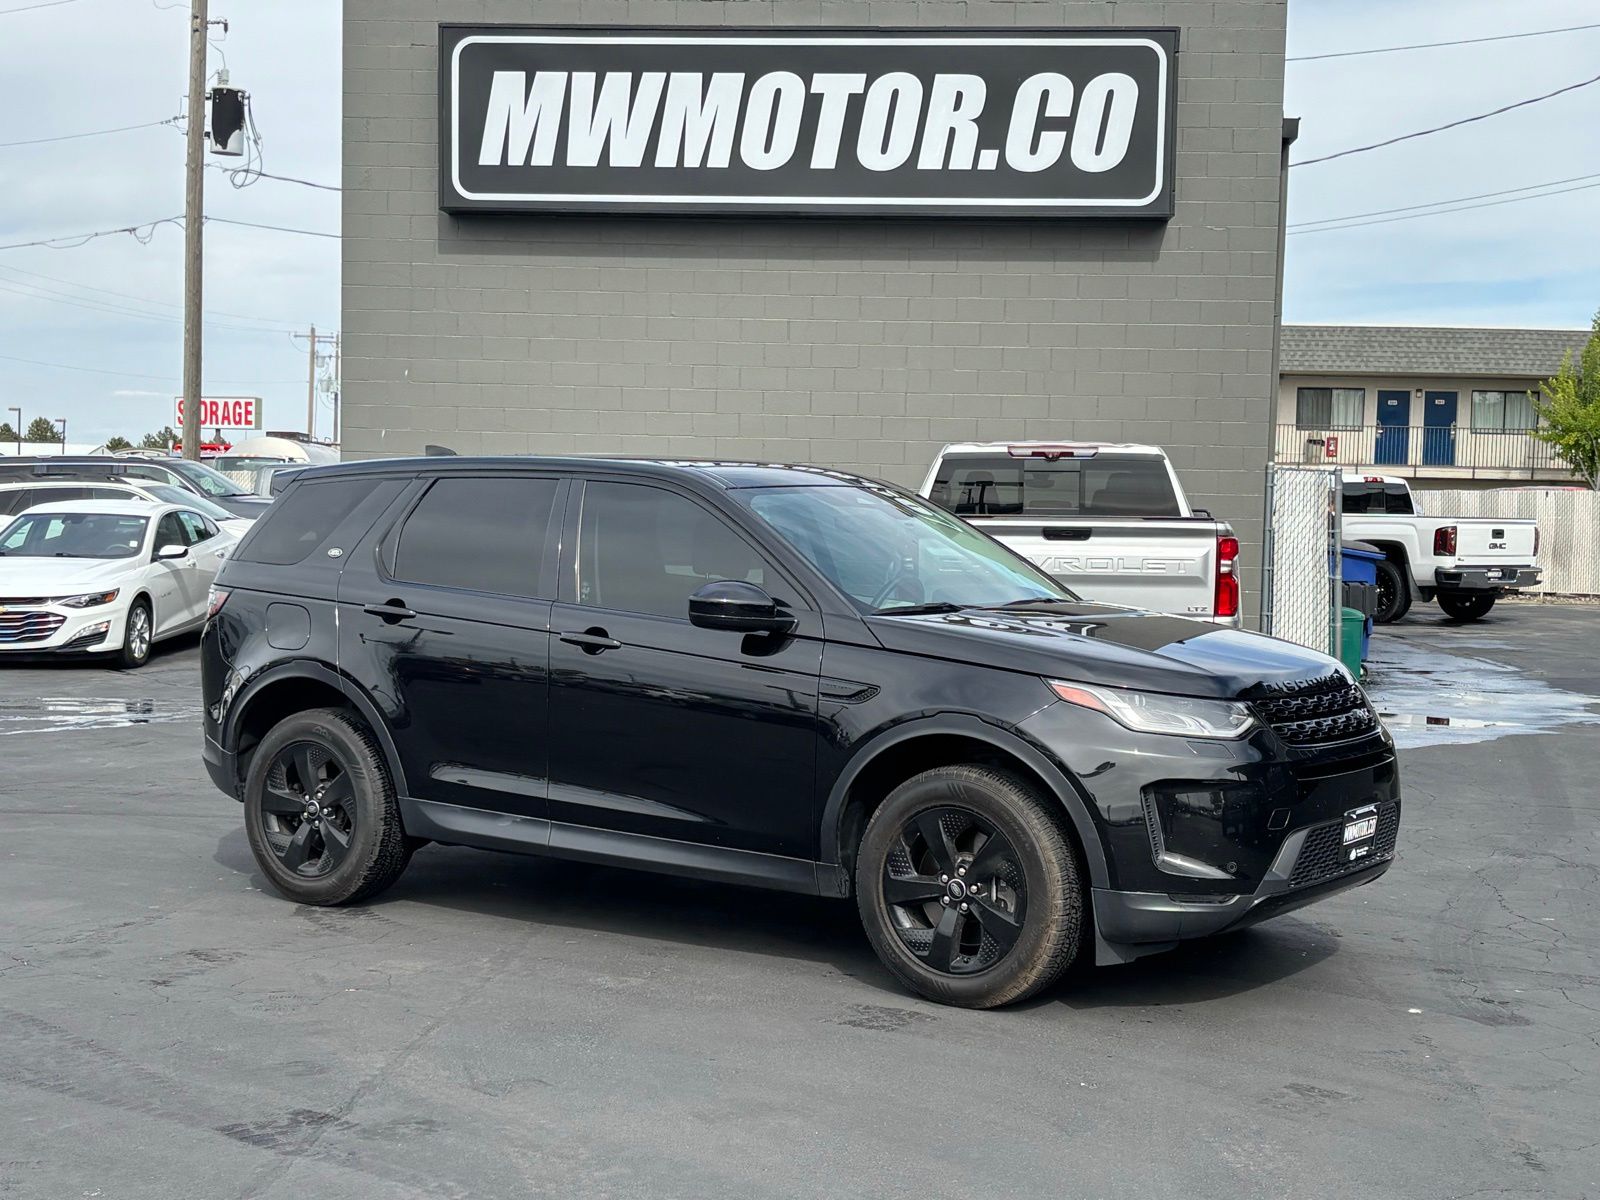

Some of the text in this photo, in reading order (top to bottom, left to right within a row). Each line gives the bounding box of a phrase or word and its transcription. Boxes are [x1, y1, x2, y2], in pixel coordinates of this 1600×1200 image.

[478, 70, 1140, 173] MWMOTOR.CO
[177, 400, 253, 426] SORAGE
[1488, 542, 1506, 550] GMC
[1027, 556, 1197, 574] VROLET
